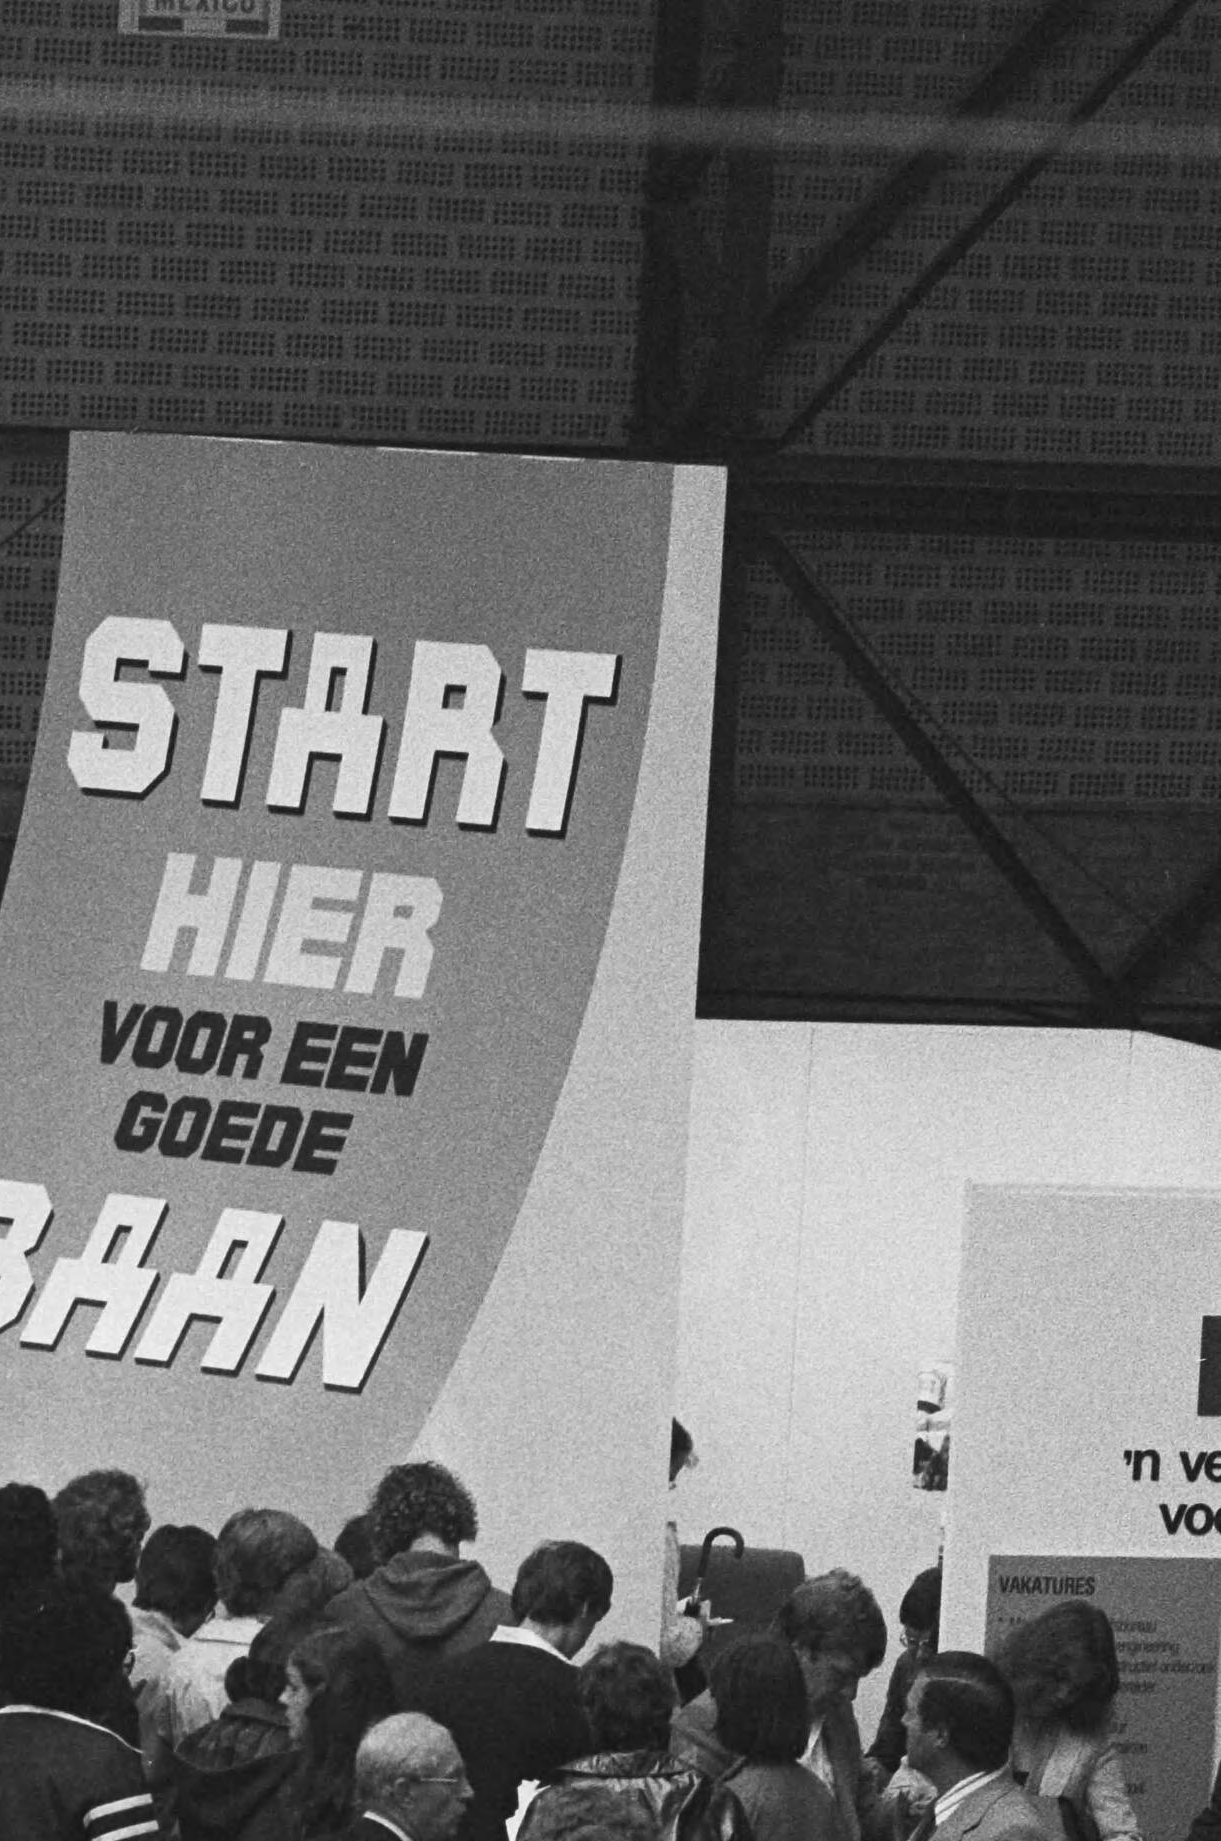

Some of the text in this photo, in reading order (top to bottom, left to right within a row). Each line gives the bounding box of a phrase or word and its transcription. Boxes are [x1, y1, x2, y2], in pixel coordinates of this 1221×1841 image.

[67, 616, 621, 838] START
[140, 853, 443, 999] HIER
[100, 1001, 429, 1097] VOOR EEN
[114, 1091, 353, 1175] GOEDE
[1159, 1503, 1221, 1536] vo
[999, 1574, 1096, 1596] VAKATURES
